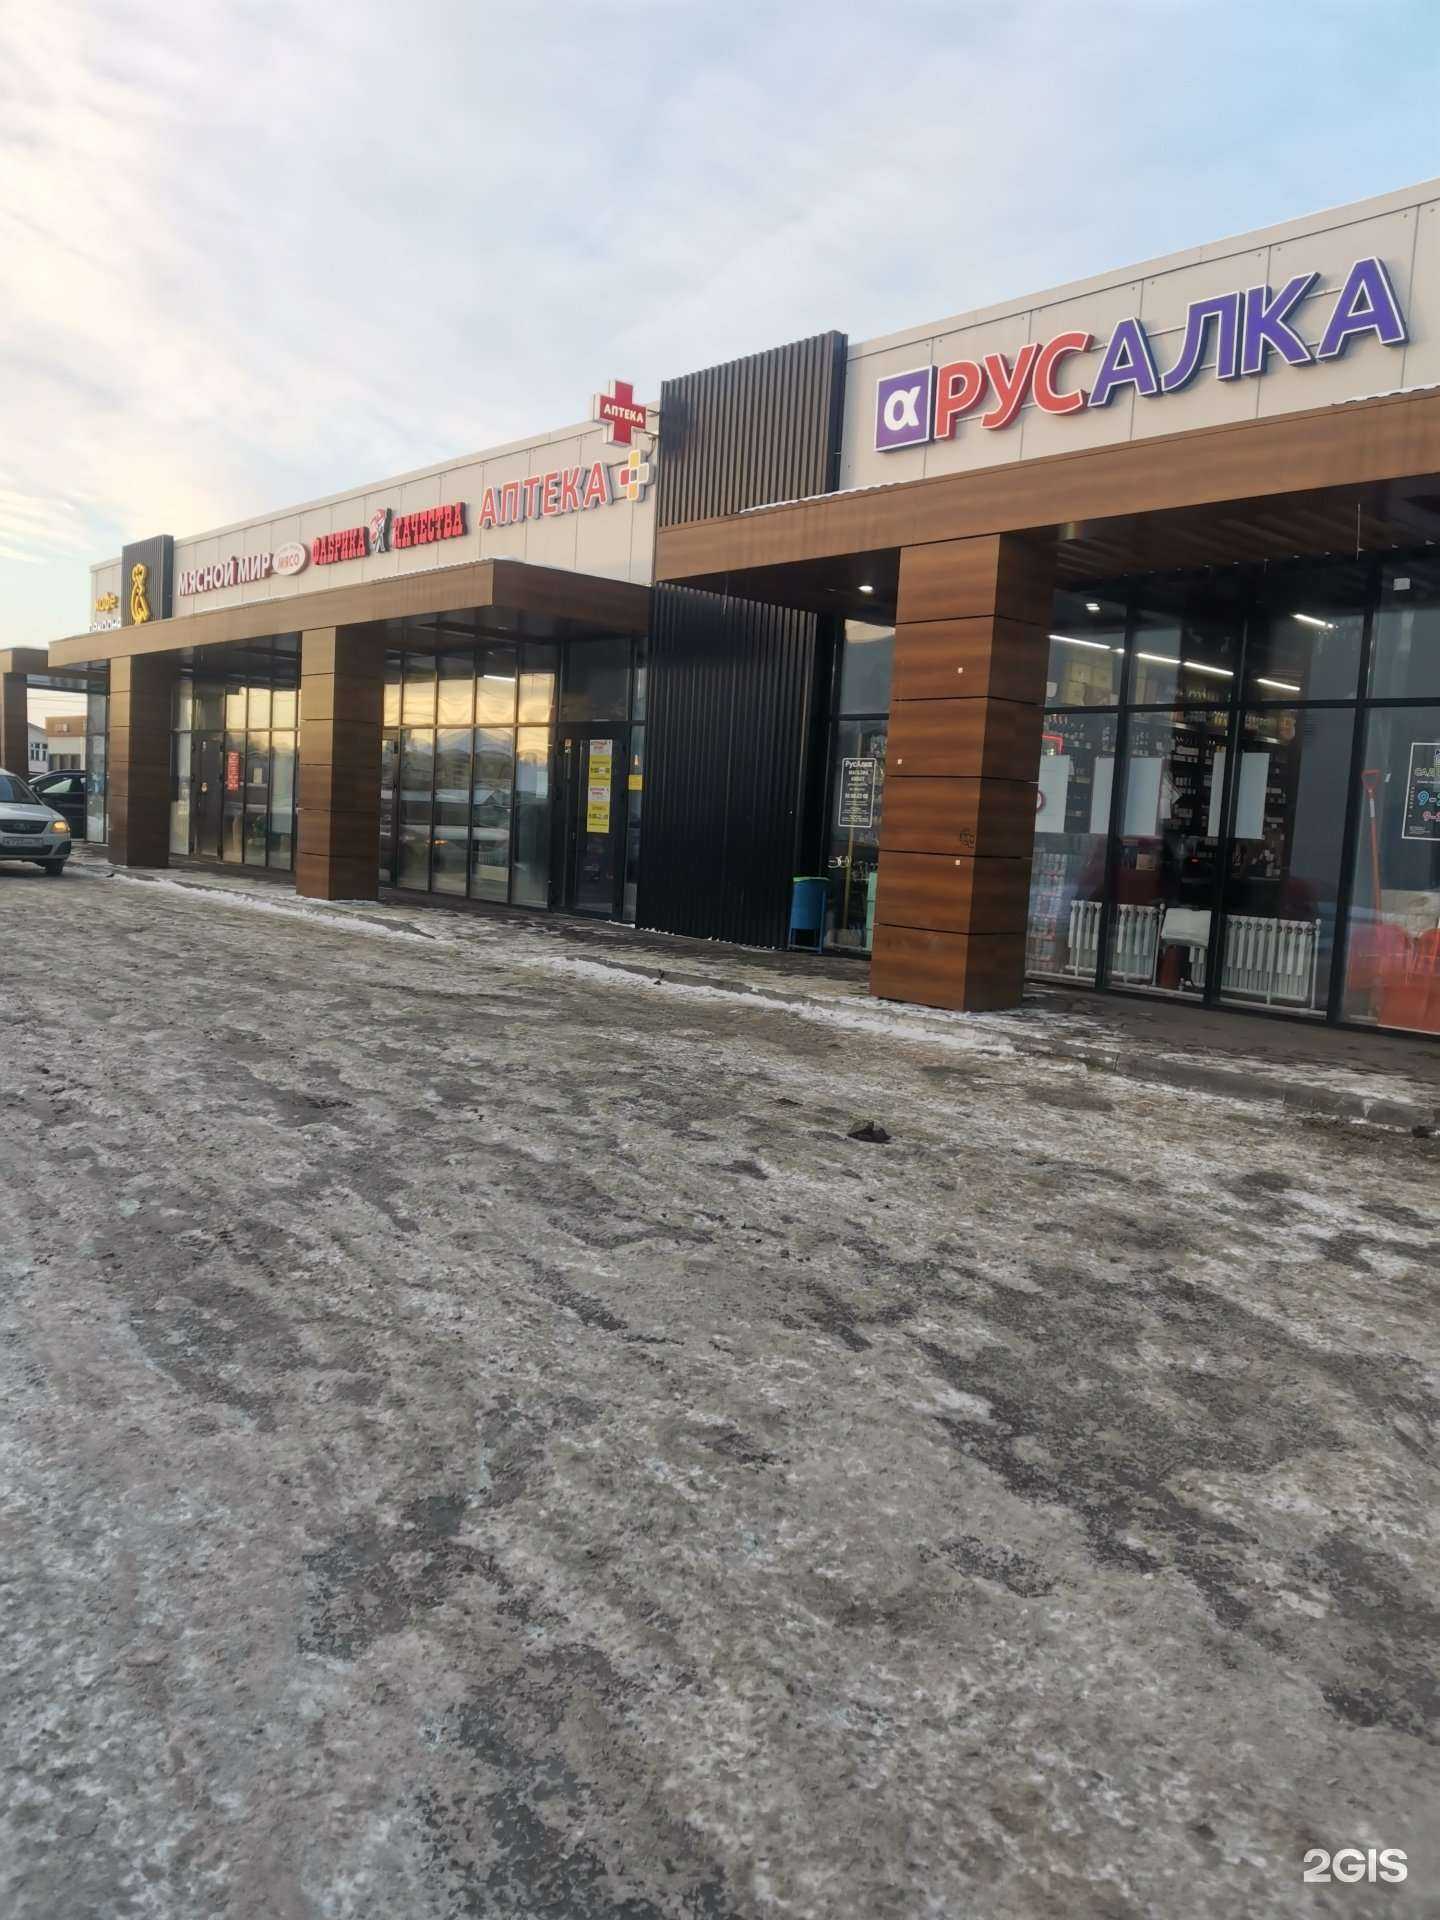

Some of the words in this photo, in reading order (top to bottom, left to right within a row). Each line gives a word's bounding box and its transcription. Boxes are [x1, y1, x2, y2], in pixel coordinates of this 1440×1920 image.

[935, 256, 1407, 440] РУСАЛКА
[603, 403, 644, 424] АПТЕКА
[479, 460, 608, 528] АПТЕКА
[312, 527, 369, 565] ФАБРИКА
[392, 502, 467, 549] КАЧЕСТВА
[178, 555, 237, 596] МЯСНОЙ
[238, 552, 273, 584] МИР
